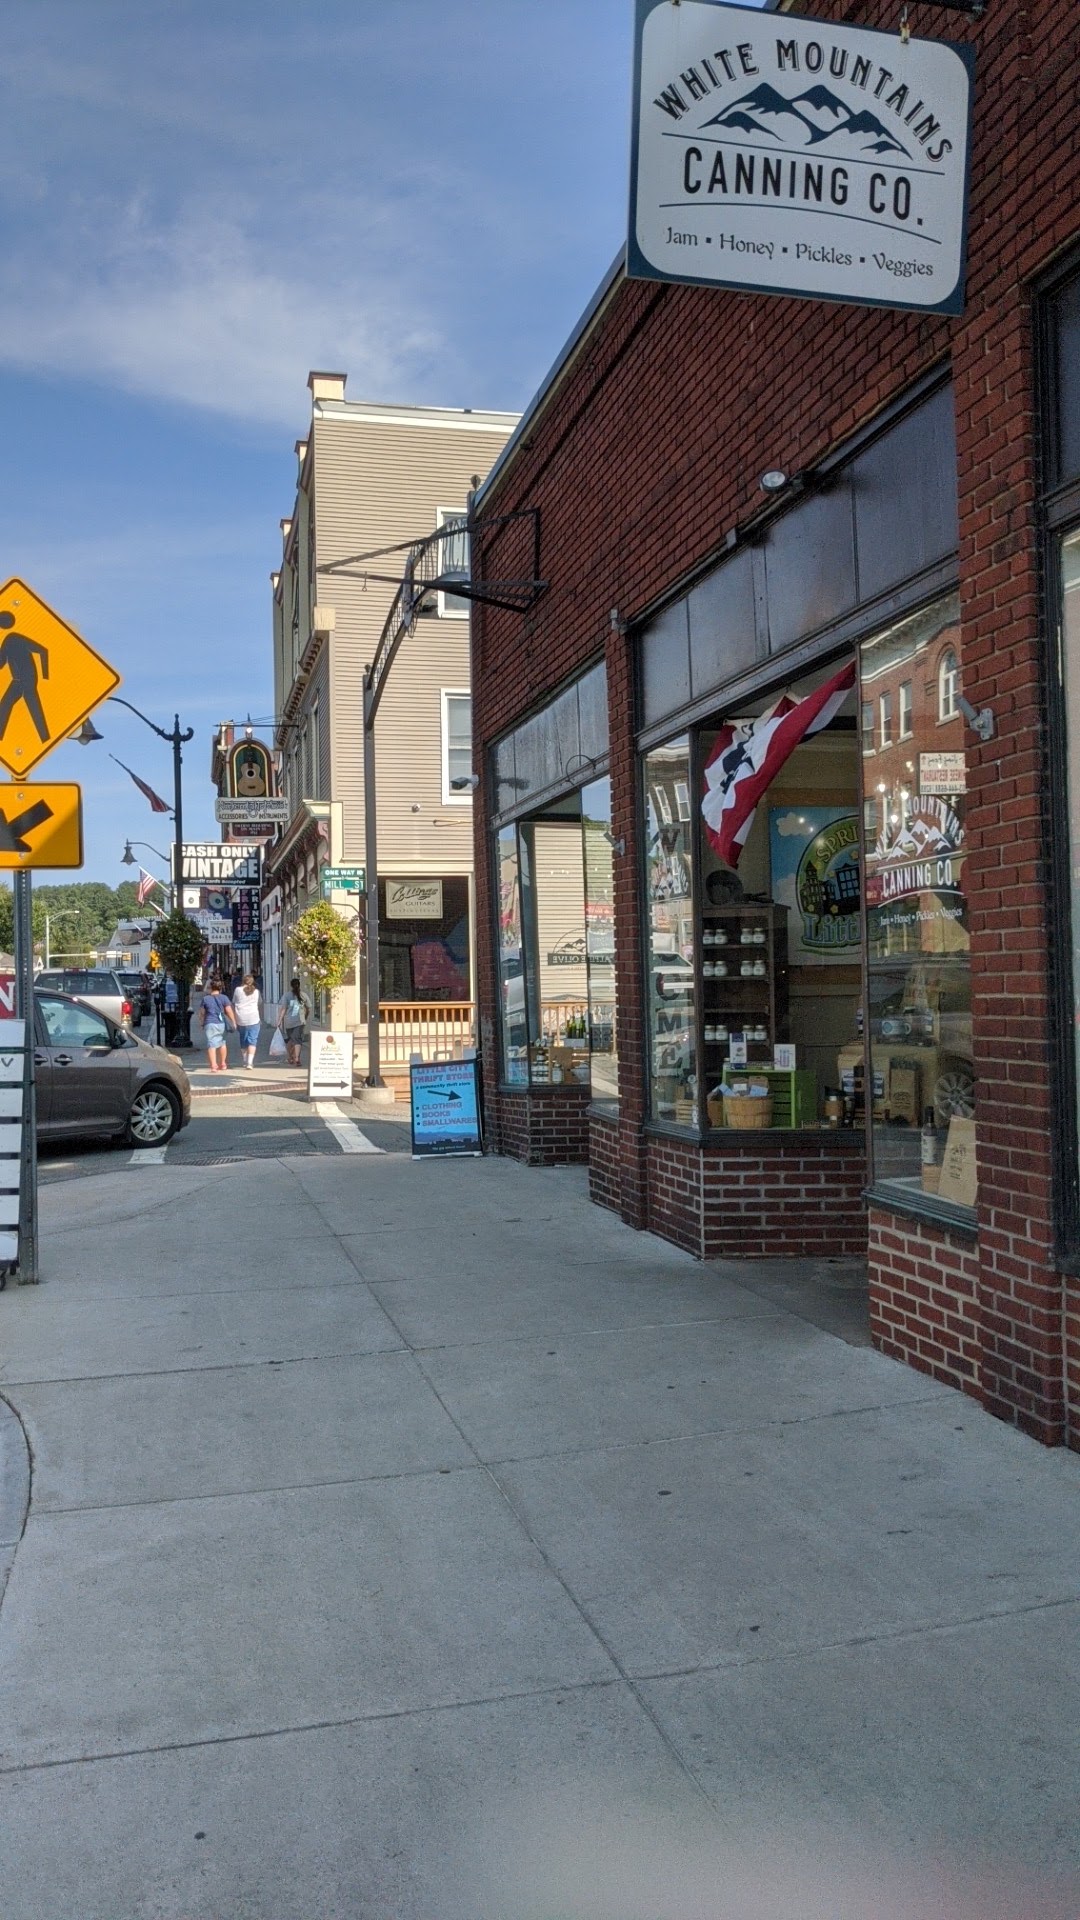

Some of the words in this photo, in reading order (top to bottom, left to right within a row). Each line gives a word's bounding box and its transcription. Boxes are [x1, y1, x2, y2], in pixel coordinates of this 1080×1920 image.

[652, 43, 759, 121] WHITE
[776, 39, 952, 162] MOUNTAINS
[683, 146, 849, 206] CANNING
[868, 173, 924, 227] CO.
[665, 227, 698, 247] Jam
[720, 232, 774, 261] Honey
[796, 243, 852, 267] Pickles
[873, 252, 934, 277] Veggies
[221, 846, 257, 858] ONLY
[324, 880, 344, 889] MILL
[882, 862, 932, 898] CANNING
[937, 859, 957, 887] CO.
[251, 889, 259, 931] PRINTS
[412, 1075, 444, 1083] THRIFT
[445, 1072, 475, 1081] STORE
[421, 1101, 462, 1110] CLOTHING
[421, 1110, 451, 1118] BOOKS
[422, 1117, 476, 1126] SMALLWARES
